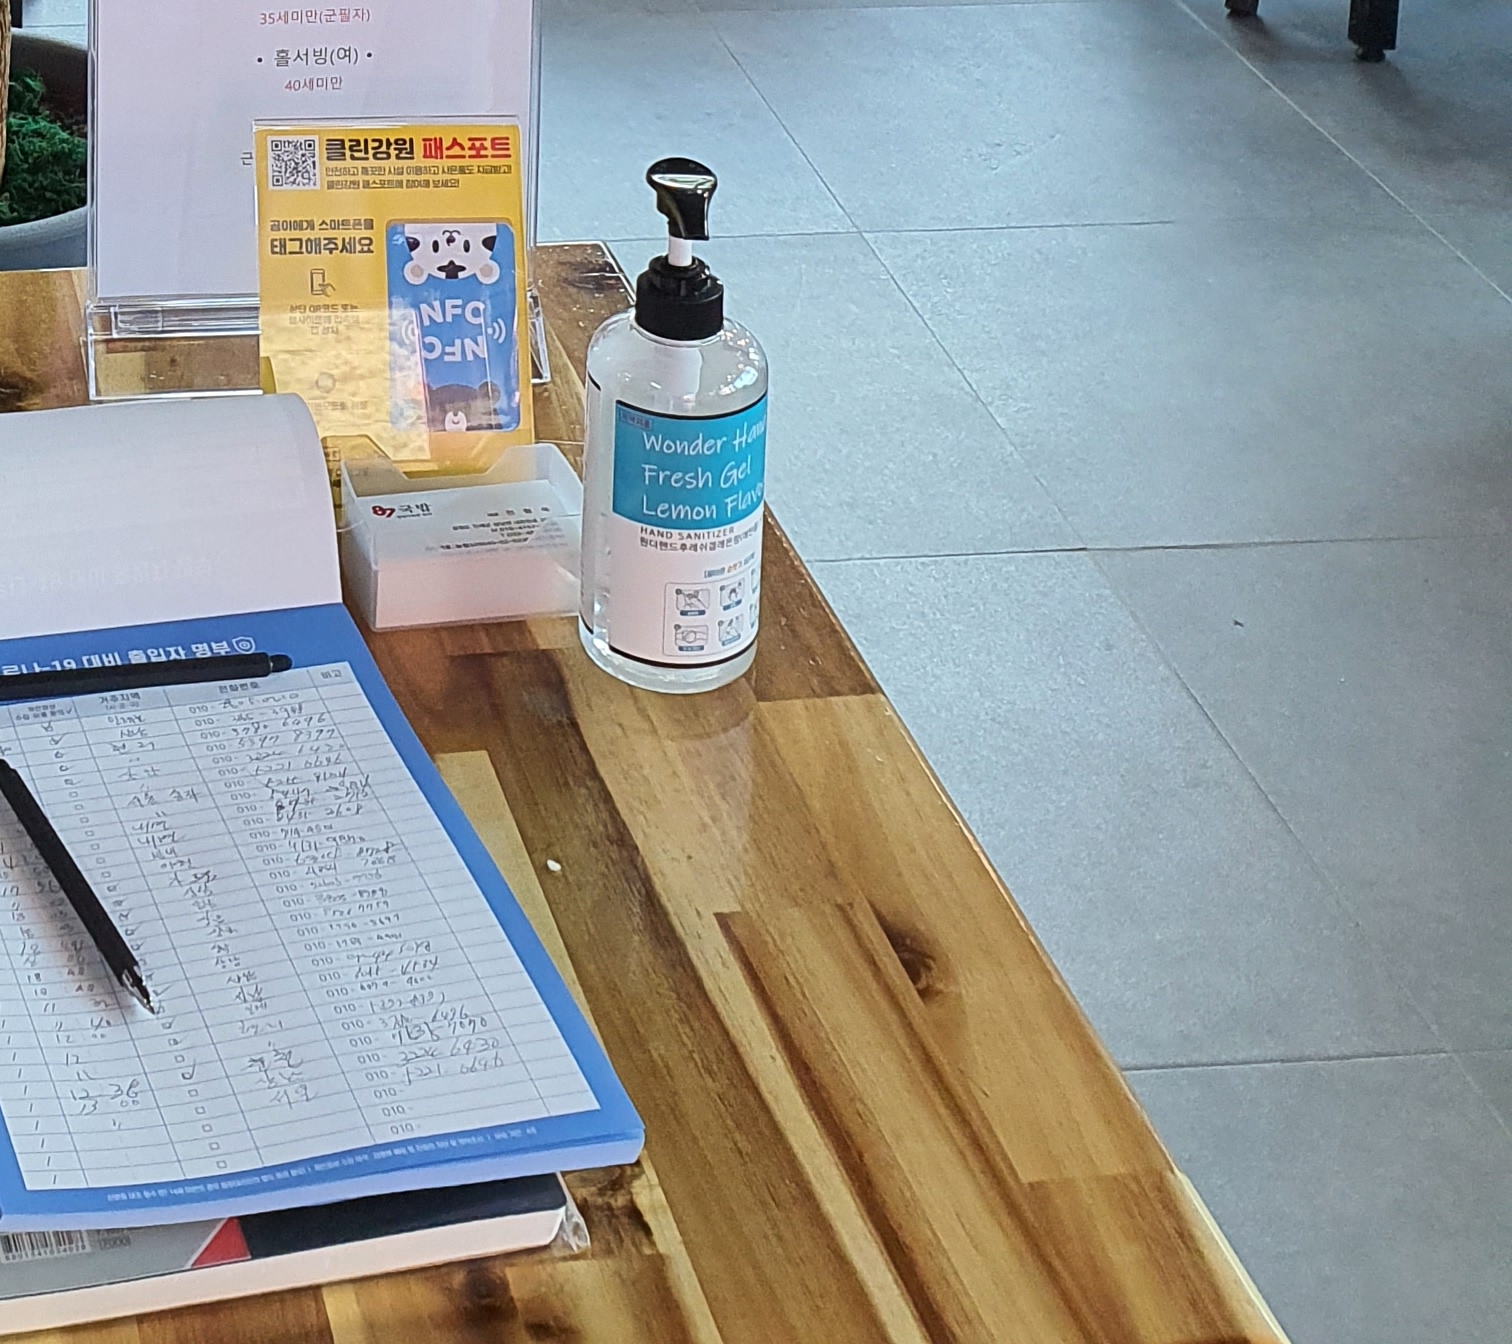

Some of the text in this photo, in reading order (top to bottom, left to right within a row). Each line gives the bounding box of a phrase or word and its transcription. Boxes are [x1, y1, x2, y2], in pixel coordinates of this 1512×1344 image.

[259, 8, 371, 25] 35세미만(군필자)
[273, 46, 359, 68] 홀서빙(여)
[284, 76, 343, 92] 40세미만
[325, 136, 512, 162] 클린강원 패스포트
[270, 237, 374, 255] 태그해주세요
[419, 299, 486, 327] NFC
[422, 336, 487, 361] NFC
[642, 430, 727, 456] Wonder
[642, 454, 751, 489] Fresh Gel
[642, 482, 763, 521] Lemon Flavo
[641, 526, 735, 541] HAND SANITIZER
[128, 646, 186, 664] 출입자
[191, 640, 231, 659] 명부
